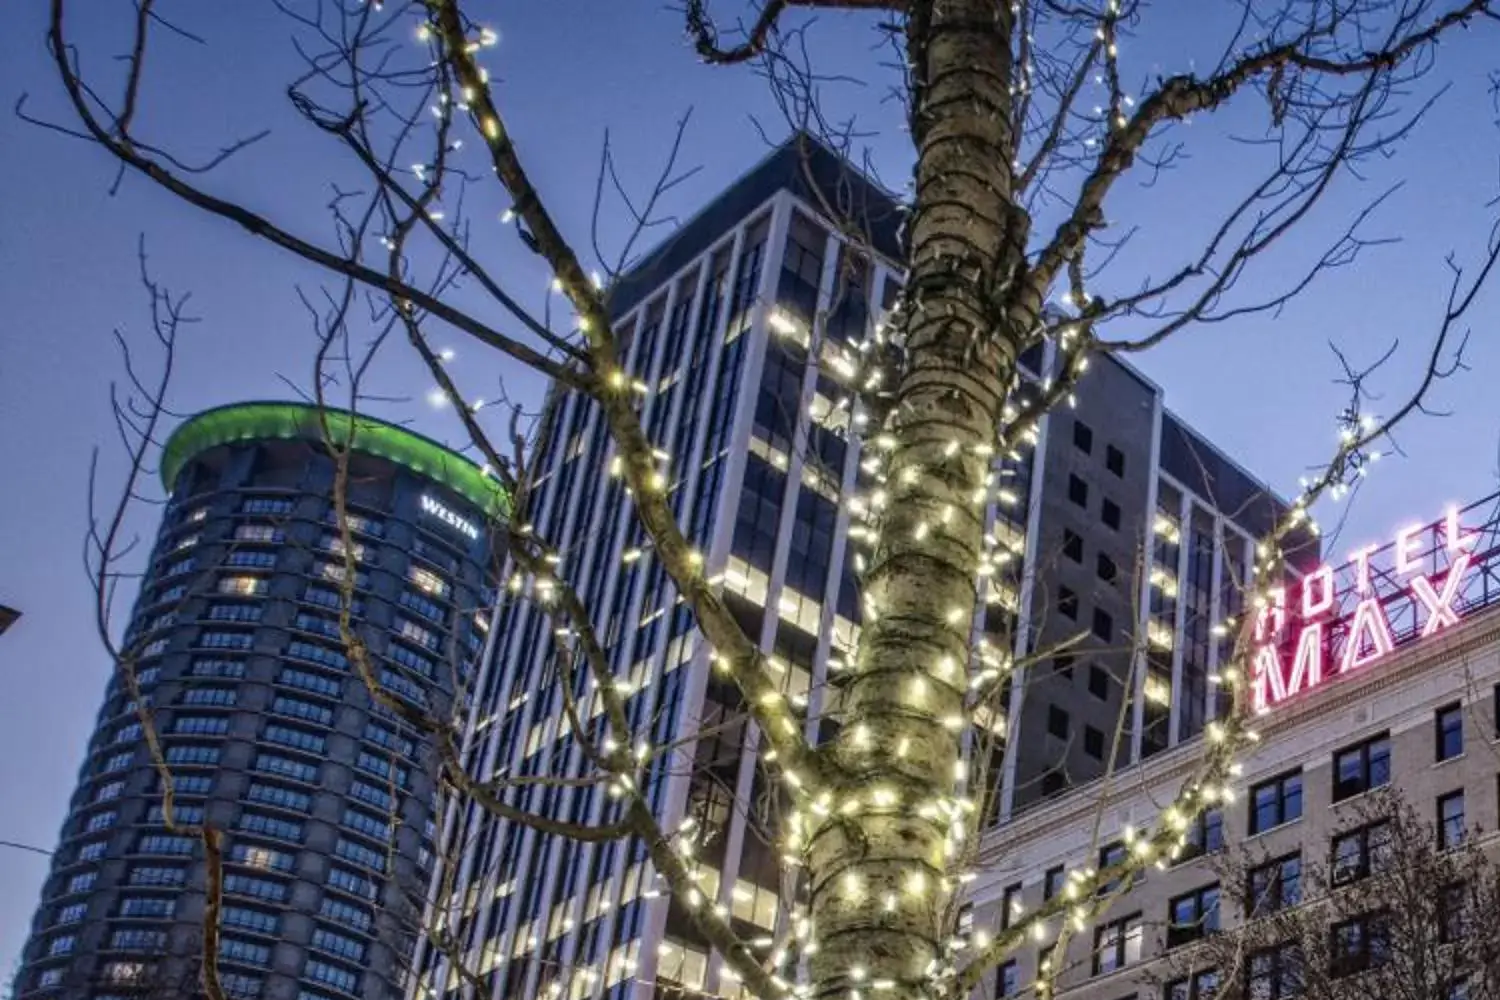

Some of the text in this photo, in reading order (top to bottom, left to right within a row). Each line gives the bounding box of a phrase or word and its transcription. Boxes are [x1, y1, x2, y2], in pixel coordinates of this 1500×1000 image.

[421, 494, 478, 539] WESTIN
[1254, 503, 1480, 644] HOTEL
[1254, 552, 1472, 716] MAX
